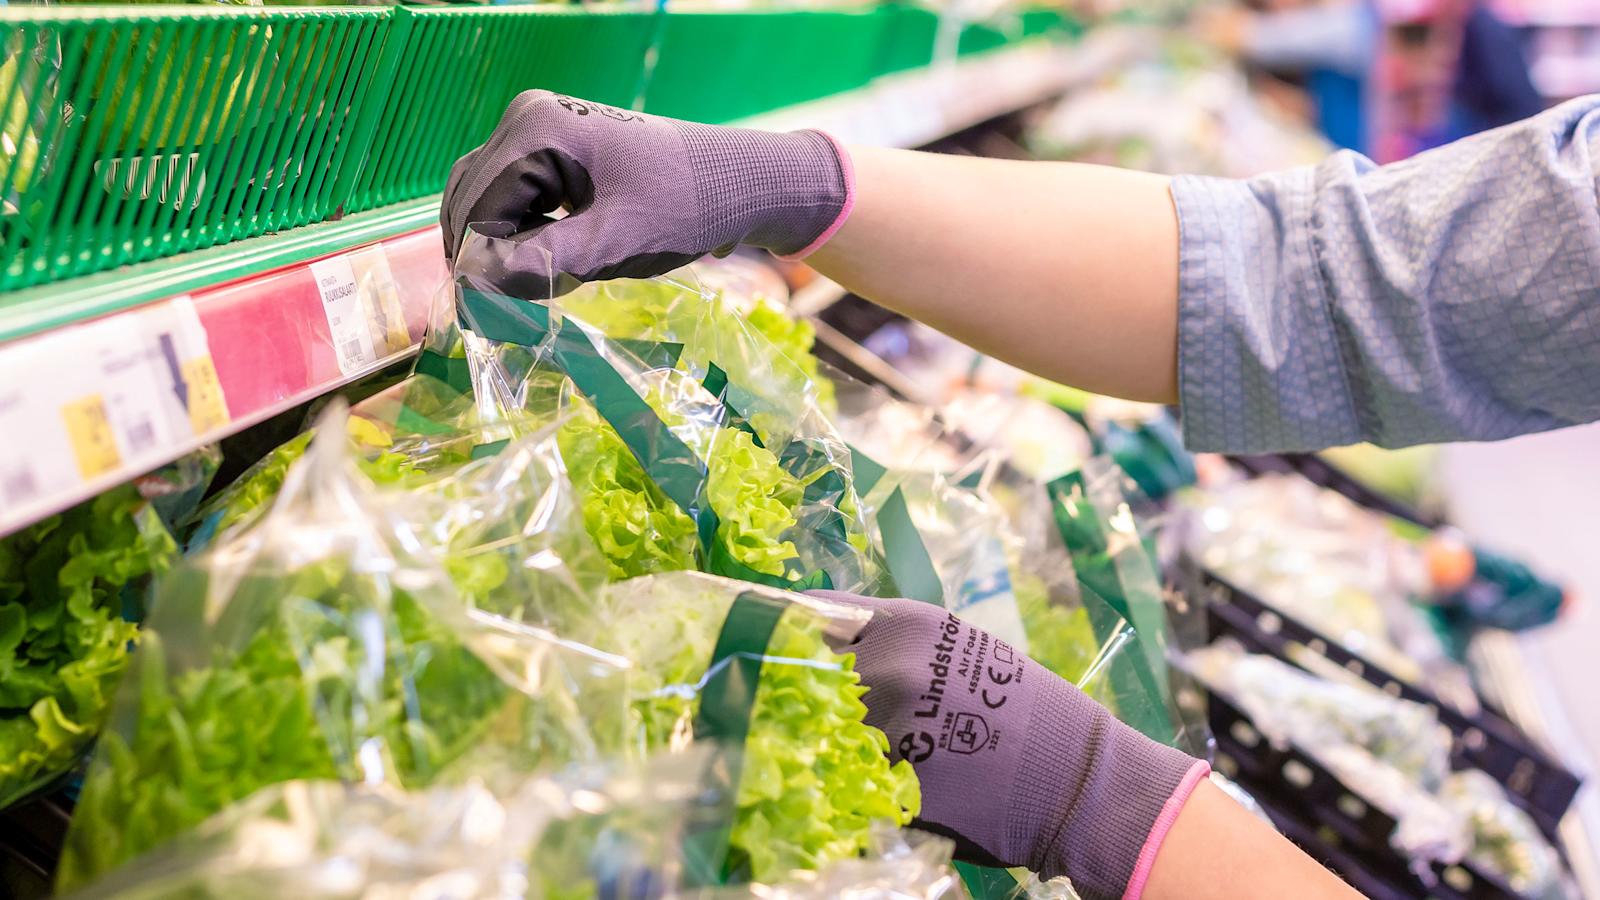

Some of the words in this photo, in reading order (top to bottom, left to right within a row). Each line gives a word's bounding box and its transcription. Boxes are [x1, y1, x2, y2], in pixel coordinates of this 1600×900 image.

[963, 628, 977, 655] Foam
[958, 657, 970, 677] Air
[988, 729, 1001, 751] 3221
